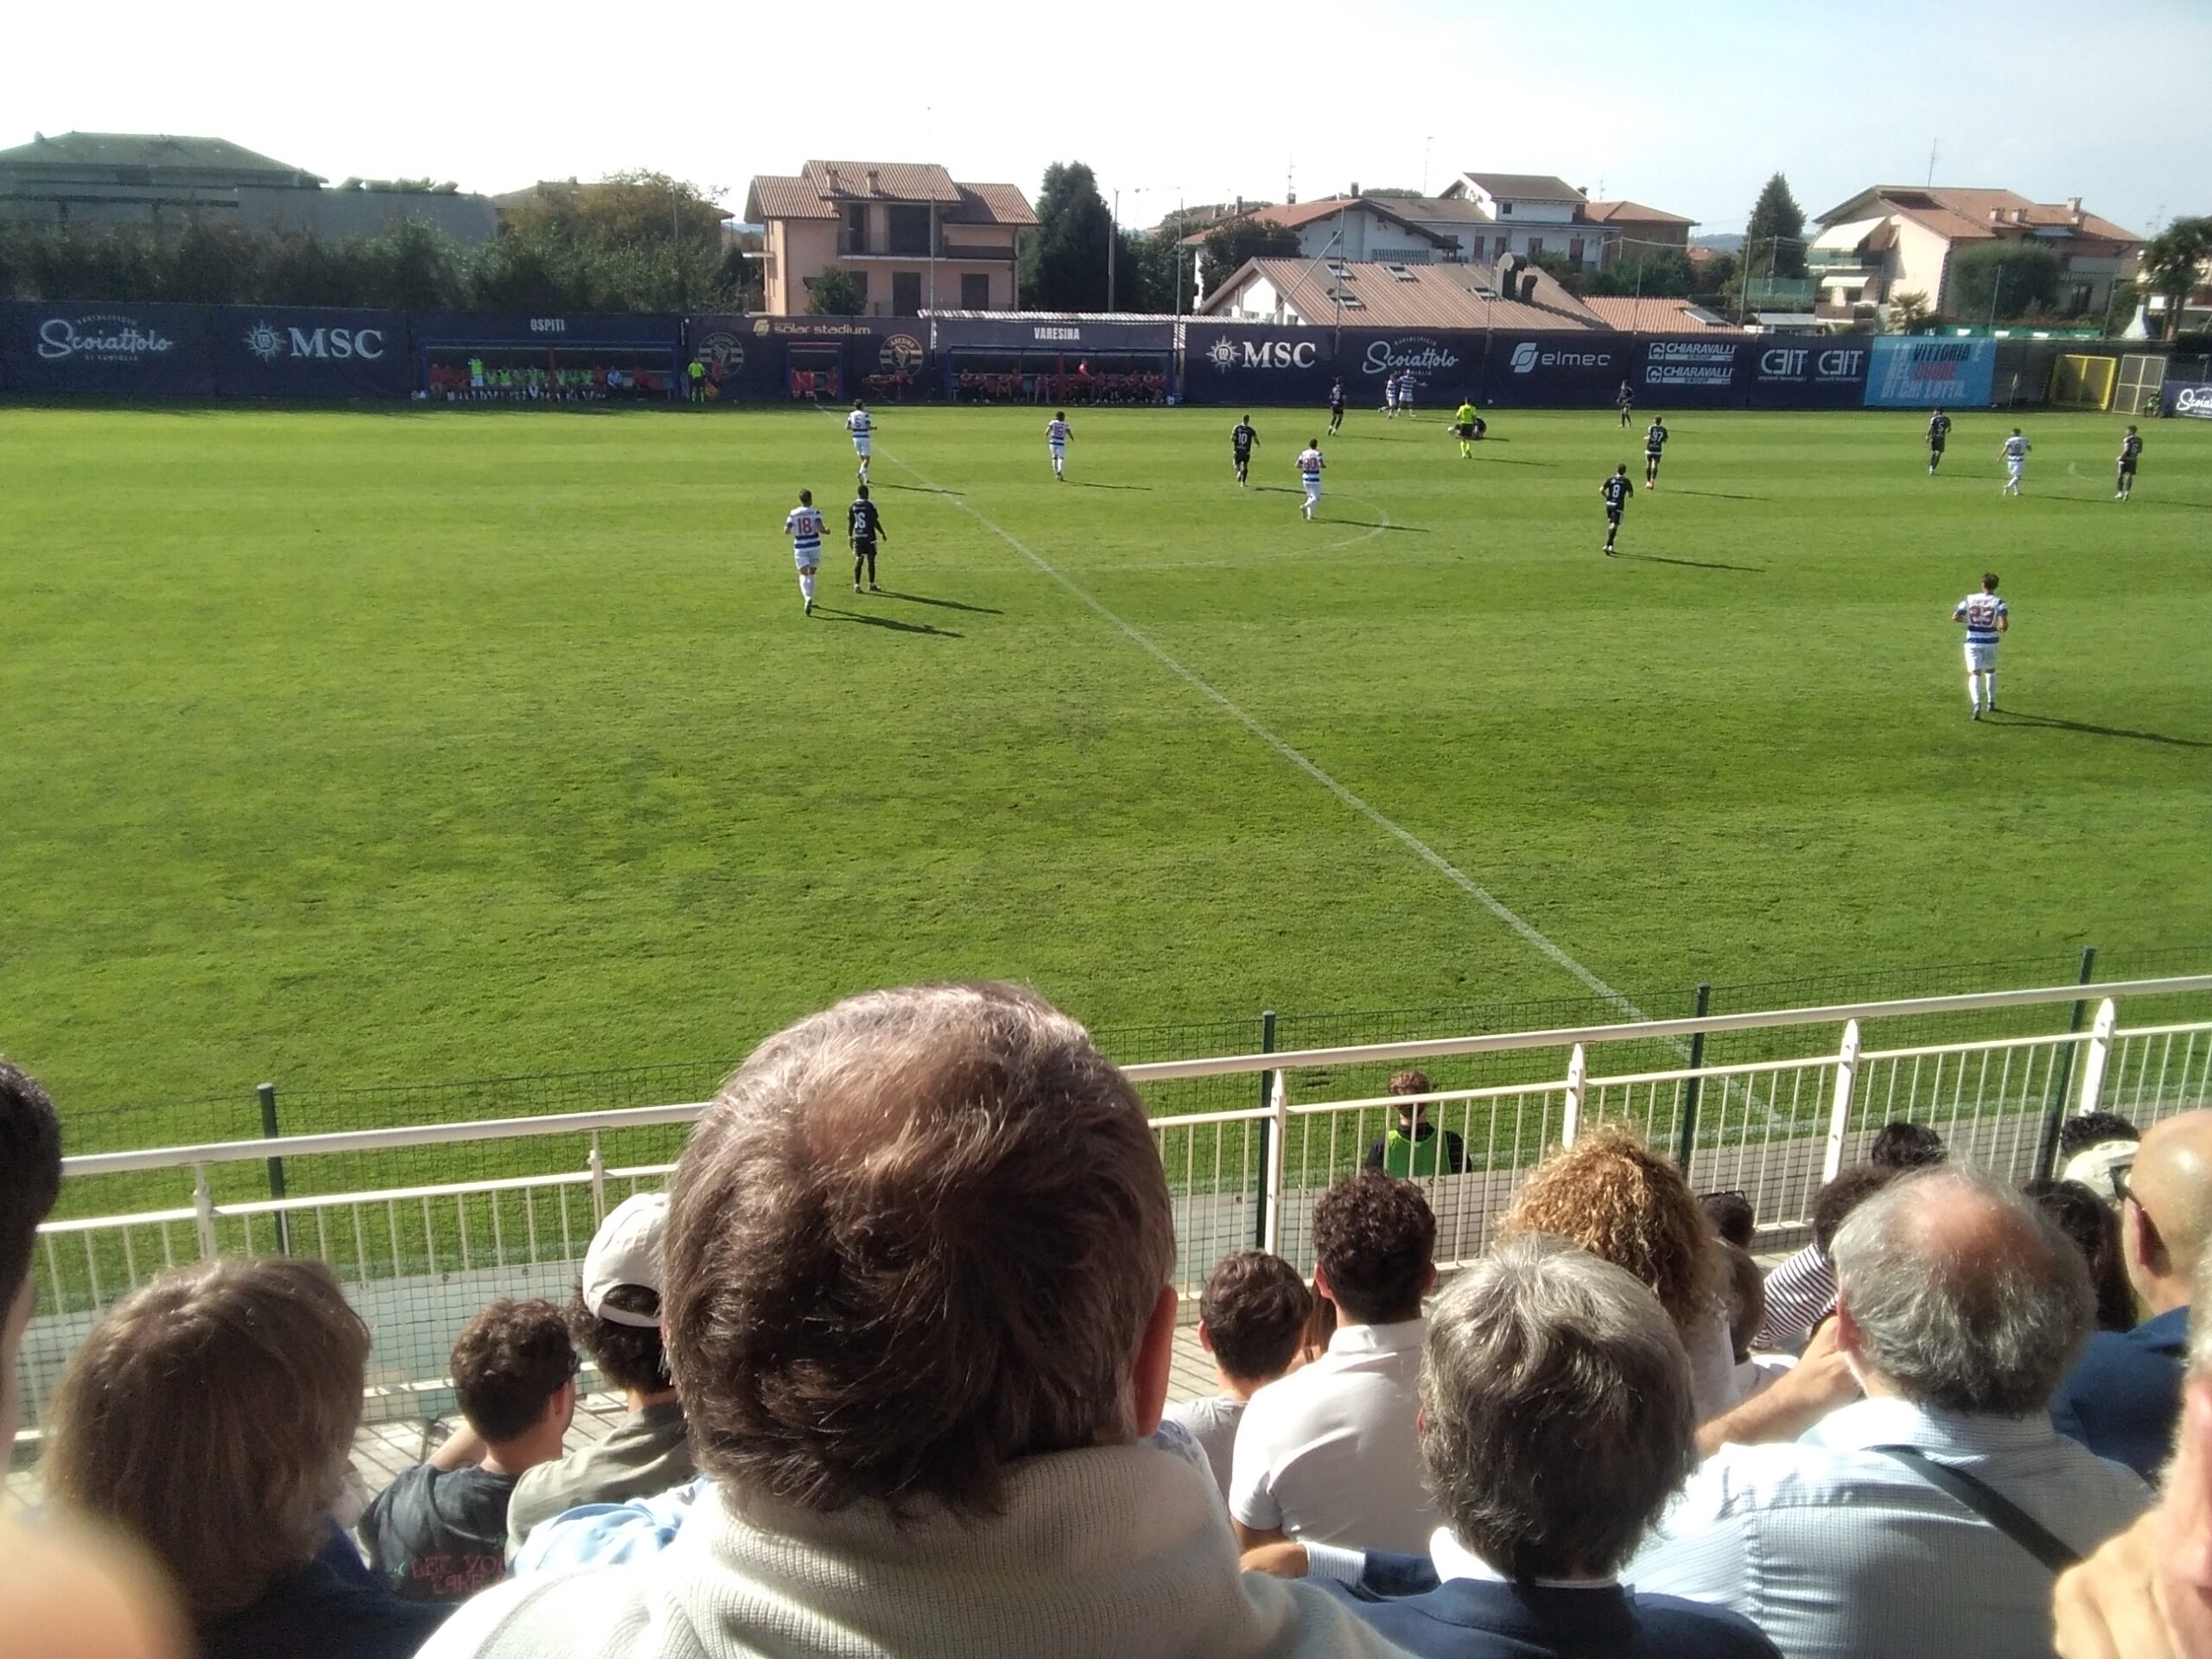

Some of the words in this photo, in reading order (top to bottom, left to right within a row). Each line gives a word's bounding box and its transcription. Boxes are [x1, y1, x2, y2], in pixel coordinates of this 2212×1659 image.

[530, 317, 565, 332] OSPITI
[773, 321, 810, 334] solar
[814, 324, 871, 335] stadium
[38, 319, 172, 358] Scoiattolo
[1033, 327, 1080, 340] VARESINA
[287, 327, 384, 359] MSC
[1666, 342, 1736, 354] CHIARAVALLI
[1242, 340, 1316, 369] MSC
[1362, 340, 1459, 374] Scoiattolo
[1541, 350, 1611, 366] elmec
[1913, 343, 1971, 361] VITTORIA
[1663, 366, 1733, 378] CHIARAVALLI
[1237, 433, 1248, 444] 10
[1611, 484, 1621, 499] 8
[797, 517, 813, 535] 18
[1968, 605, 1996, 627] 23
